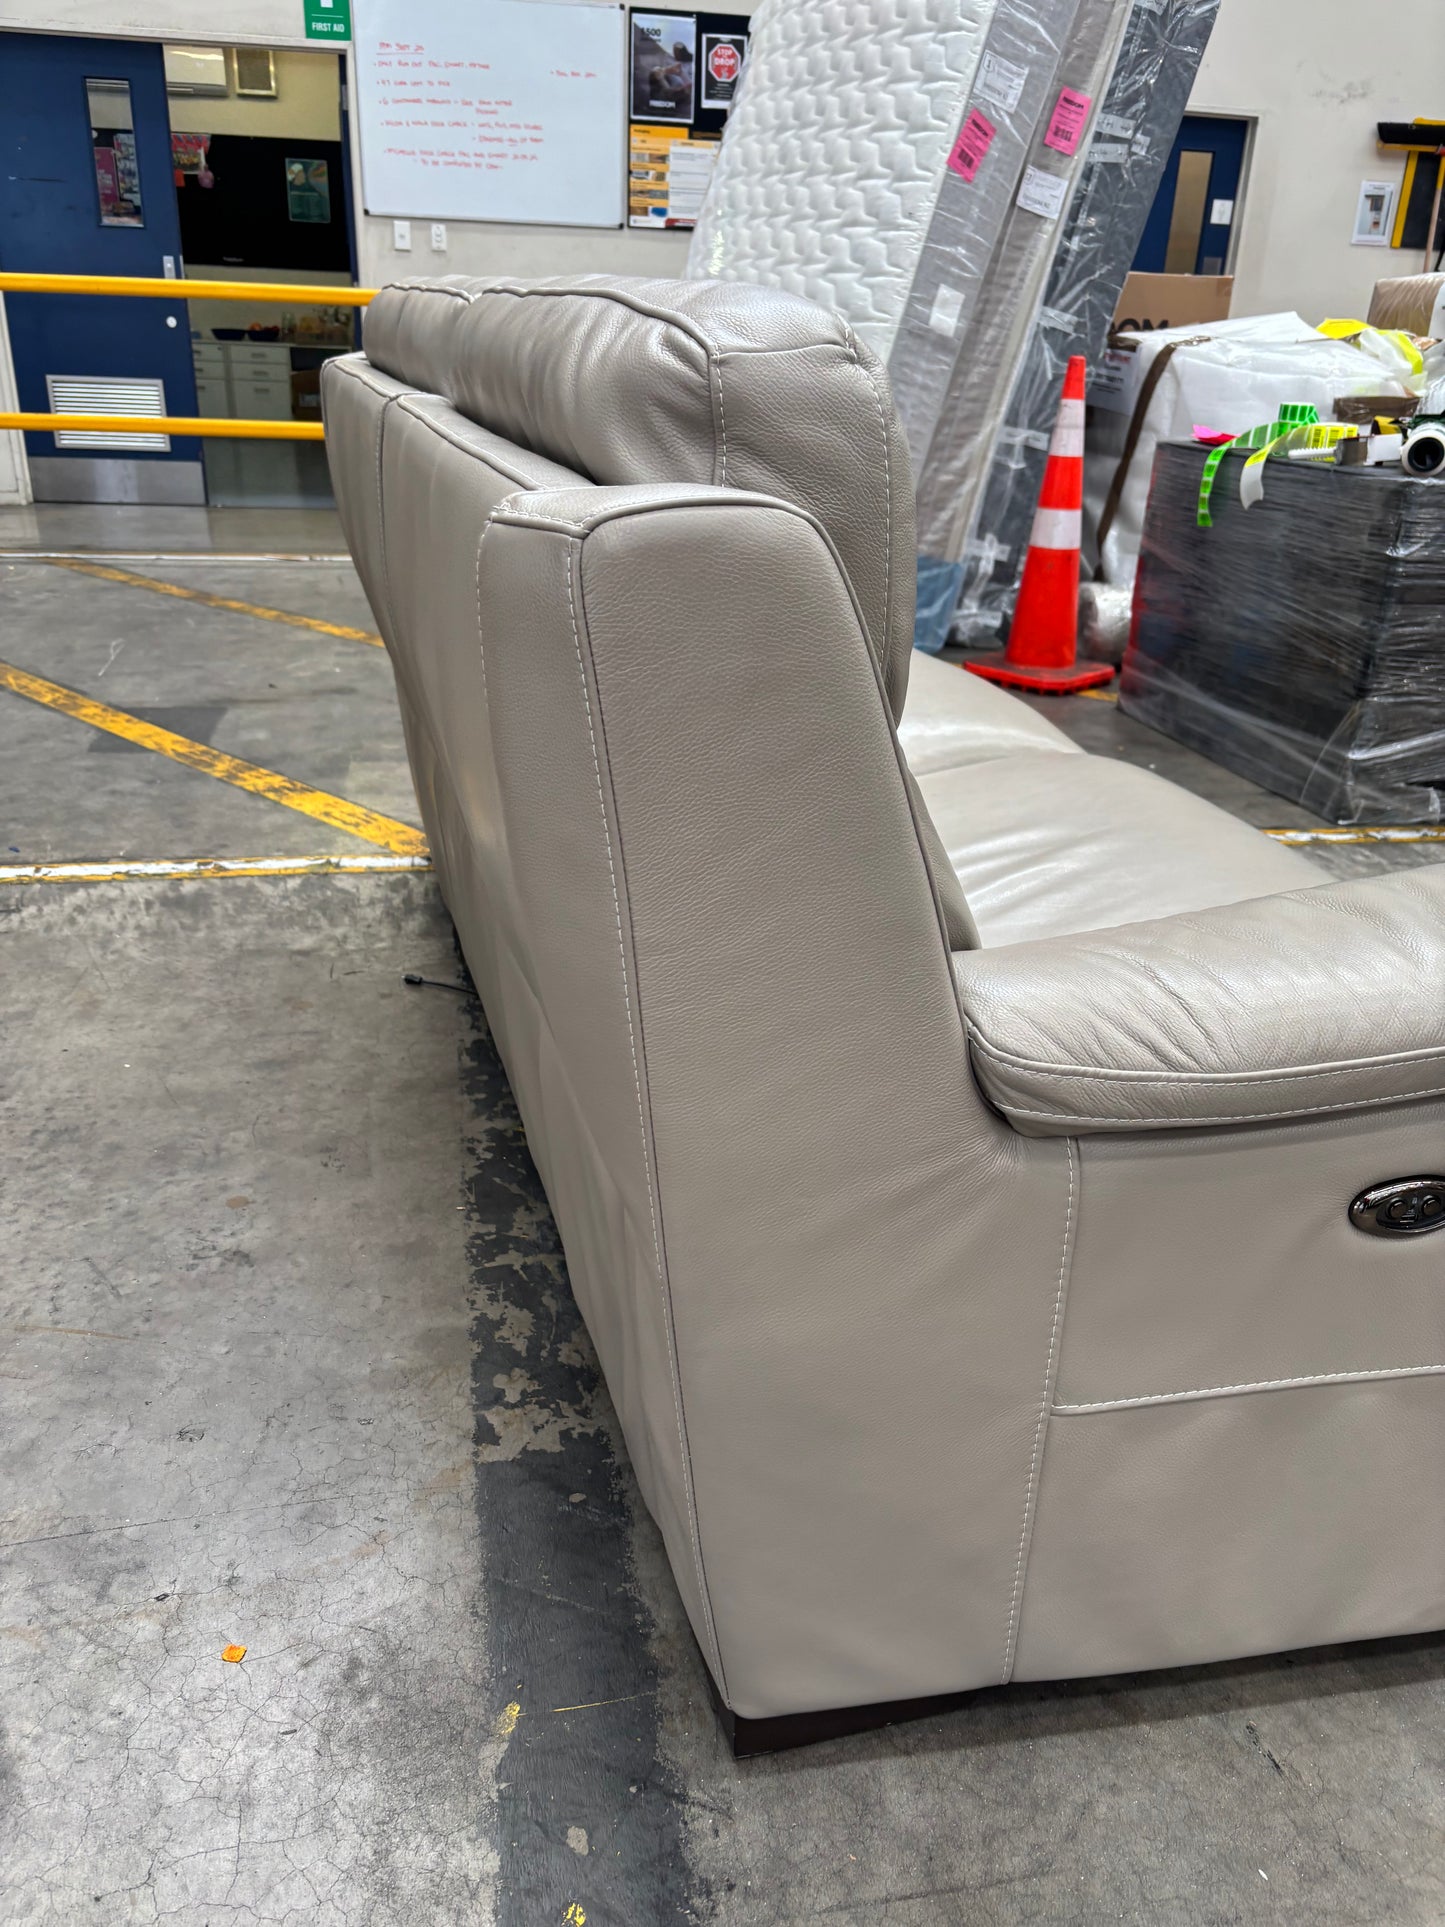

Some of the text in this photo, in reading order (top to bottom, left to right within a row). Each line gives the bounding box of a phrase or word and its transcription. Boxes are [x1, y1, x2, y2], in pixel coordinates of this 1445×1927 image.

[311, 22, 345, 33] FIRST AID
[717, 48, 733, 56] STOP
[714, 57, 736, 66] DROP
[1114, 318, 1169, 333] OM
